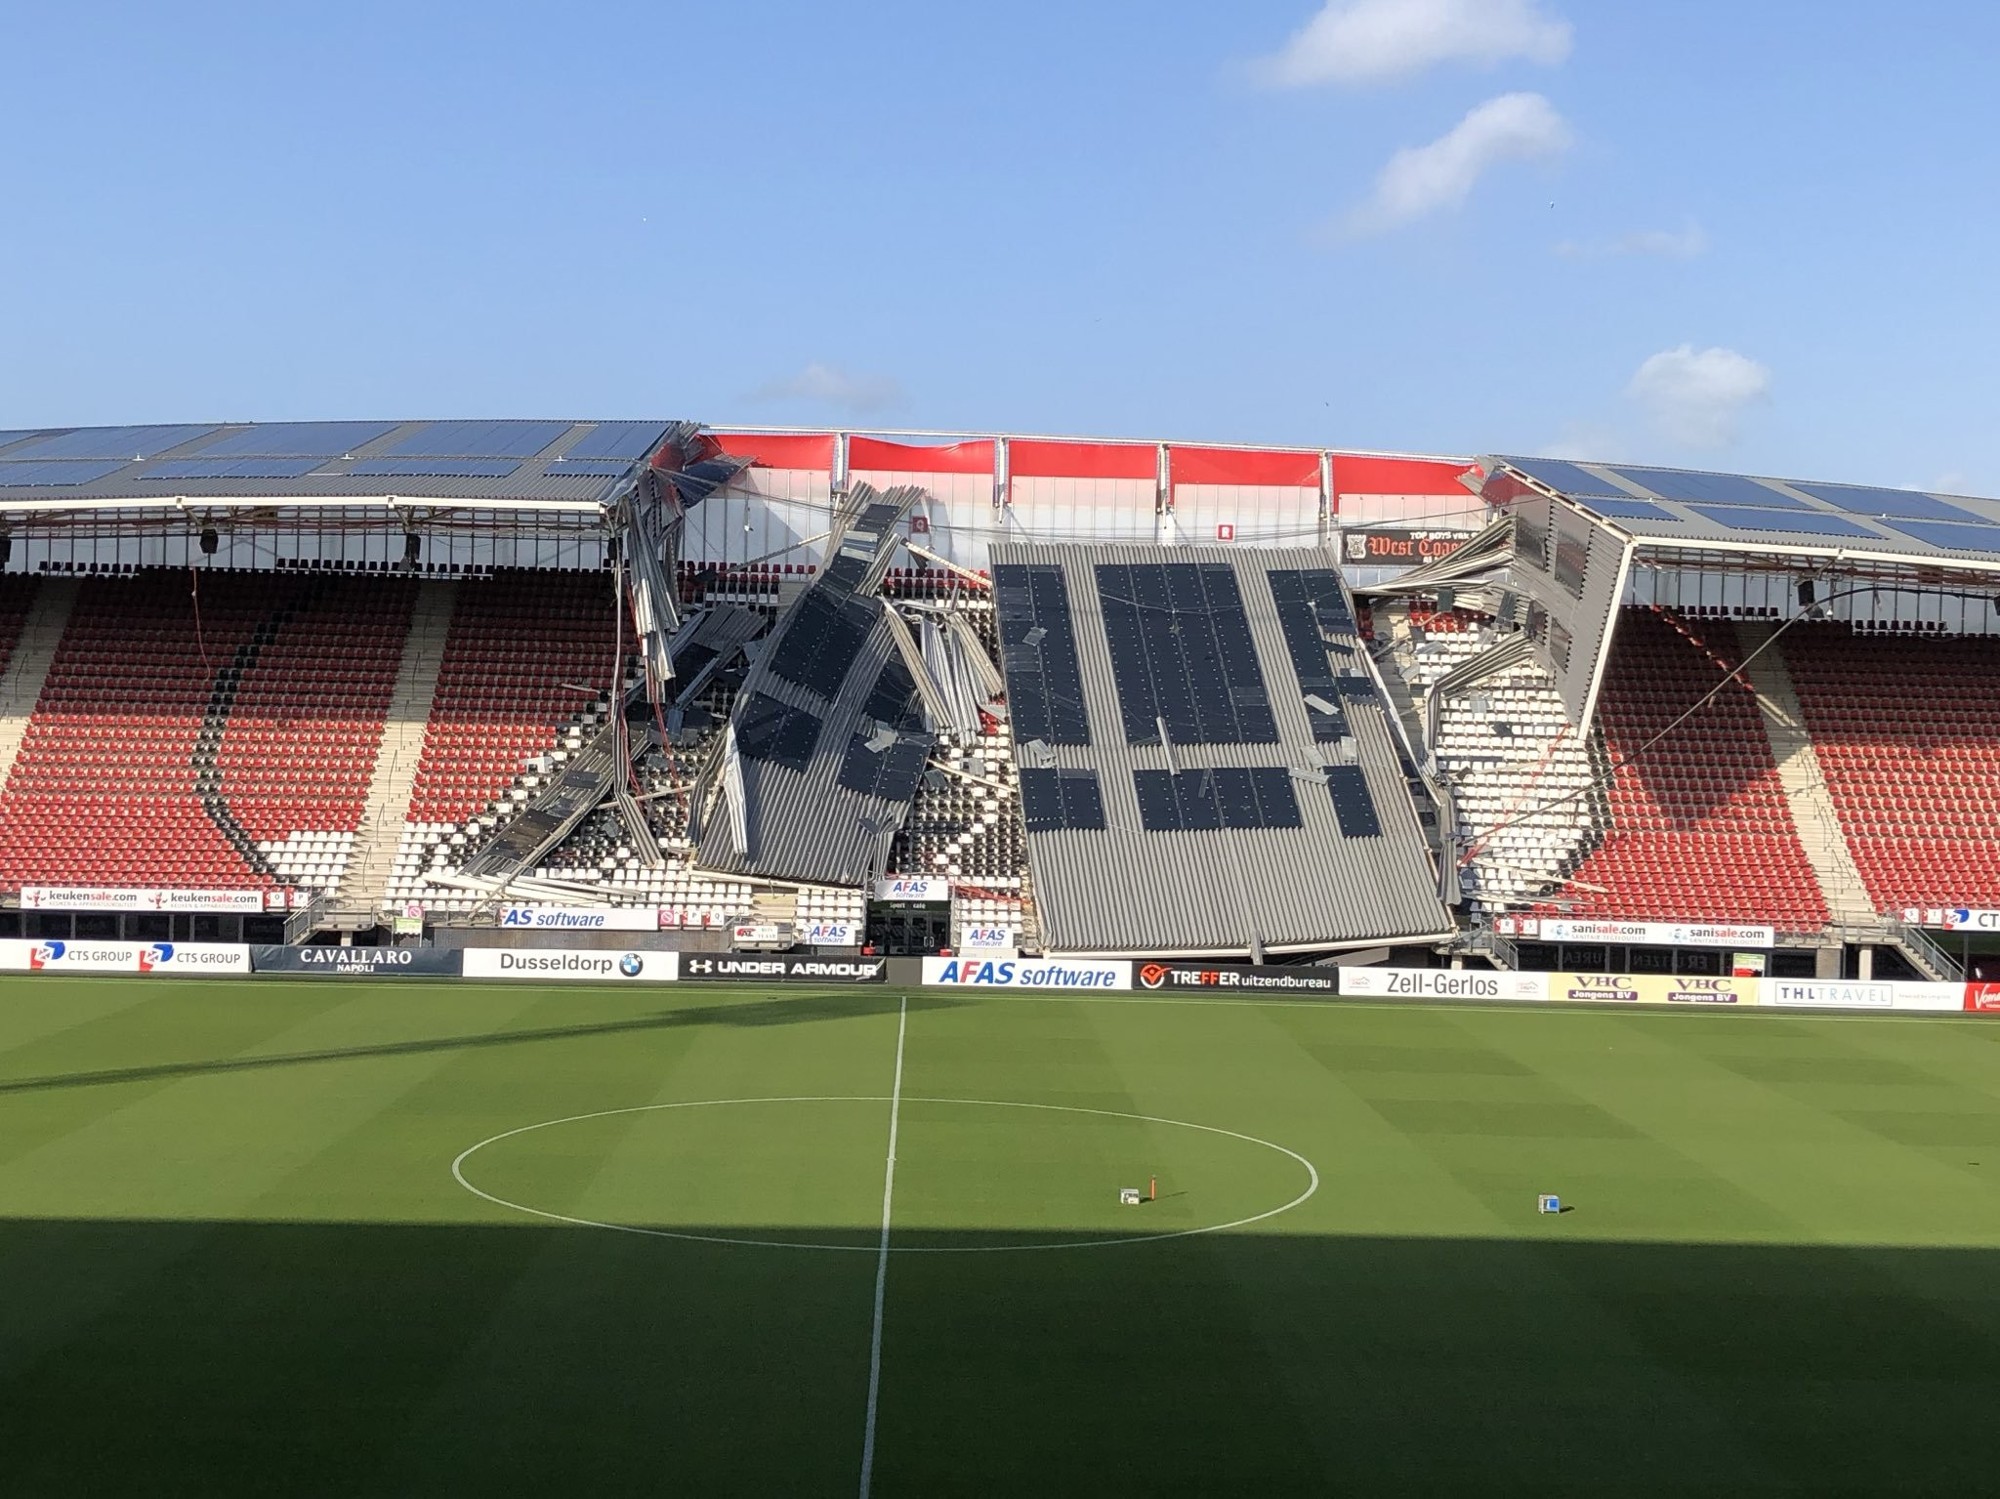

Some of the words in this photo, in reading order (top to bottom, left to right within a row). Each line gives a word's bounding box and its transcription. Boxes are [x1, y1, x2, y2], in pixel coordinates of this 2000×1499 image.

[1221, 526, 1230, 538] R
[1368, 537, 1414, 556] West
[1418, 538, 1467, 556] Coas
[893, 881, 928, 892] AFAS
[49, 890, 137, 902] keukensale.com
[171, 892, 258, 903] keukensale.com
[536, 912, 604, 927] software
[1978, 913, 2000, 927] CT
[809, 926, 847, 937] AFAS
[969, 929, 1006, 940] AFAS
[1571, 923, 1646, 935] sanisale.com
[1690, 927, 1765, 939] sanisale.com
[68, 950, 89, 961] CTS
[92, 951, 132, 962] GROUP
[177, 952, 198, 963] CTS
[200, 953, 241, 964] GROUP
[300, 949, 412, 964] CAVALLARO
[337, 965, 375, 973] NAPOLI
[501, 953, 613, 974] Dusseldorp
[718, 961, 785, 974] UNDER
[790, 962, 877, 976] ARMOUR
[939, 961, 1015, 984] AFAS
[1020, 965, 1116, 987] software
[1171, 970, 1239, 986] TREFFER
[1241, 975, 1331, 988] uitzendbureau
[1387, 973, 1498, 996] Zell-Gerlos
[1574, 975, 1632, 990] VHC
[1674, 978, 1731, 992] VHC
[1616, 991, 1632, 1000] BV
[1672, 992, 1715, 1003] Jongens
[1716, 993, 1731, 1002] BV
